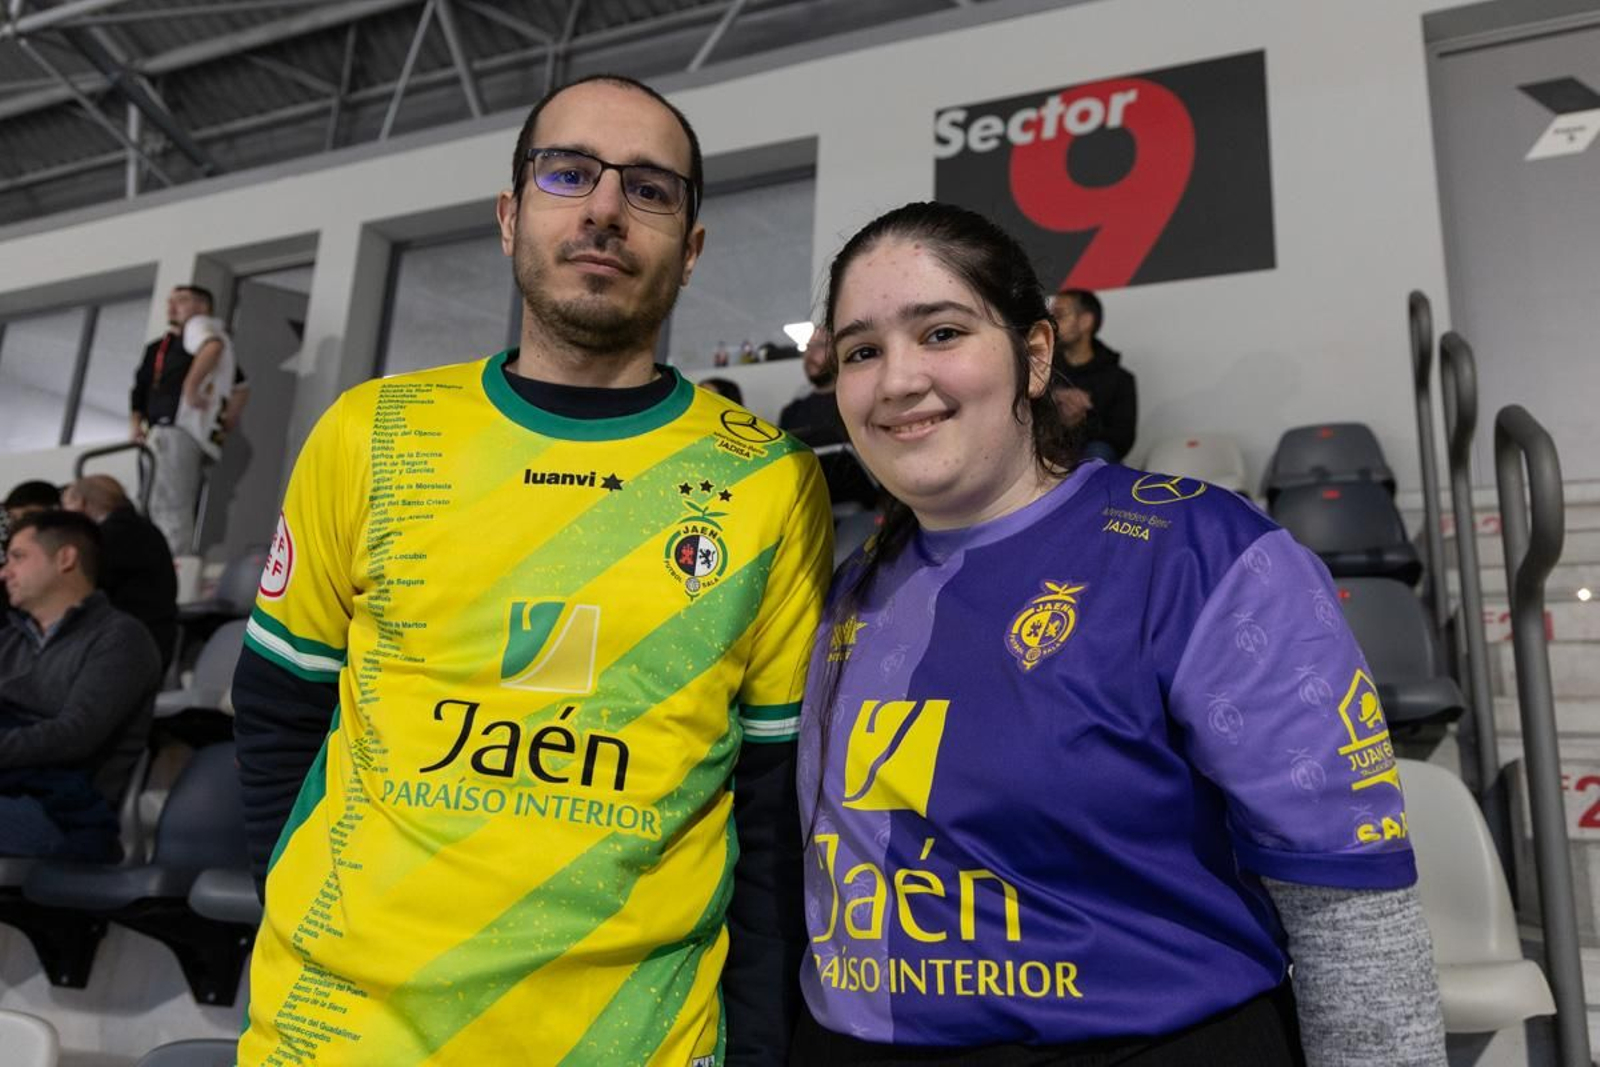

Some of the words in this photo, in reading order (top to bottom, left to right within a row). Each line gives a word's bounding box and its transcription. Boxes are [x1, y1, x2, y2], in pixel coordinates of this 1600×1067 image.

[934, 88, 1139, 159] Sector
[1009, 77, 1196, 292] 9
[1102, 518, 1150, 541] JADISA
[419, 698, 630, 792] Jaén
[382, 776, 507, 814] PARAÍSO
[513, 791, 658, 835] INTERIOR
[813, 832, 1022, 944] Jaén
[888, 957, 1084, 999] INTERIOR
